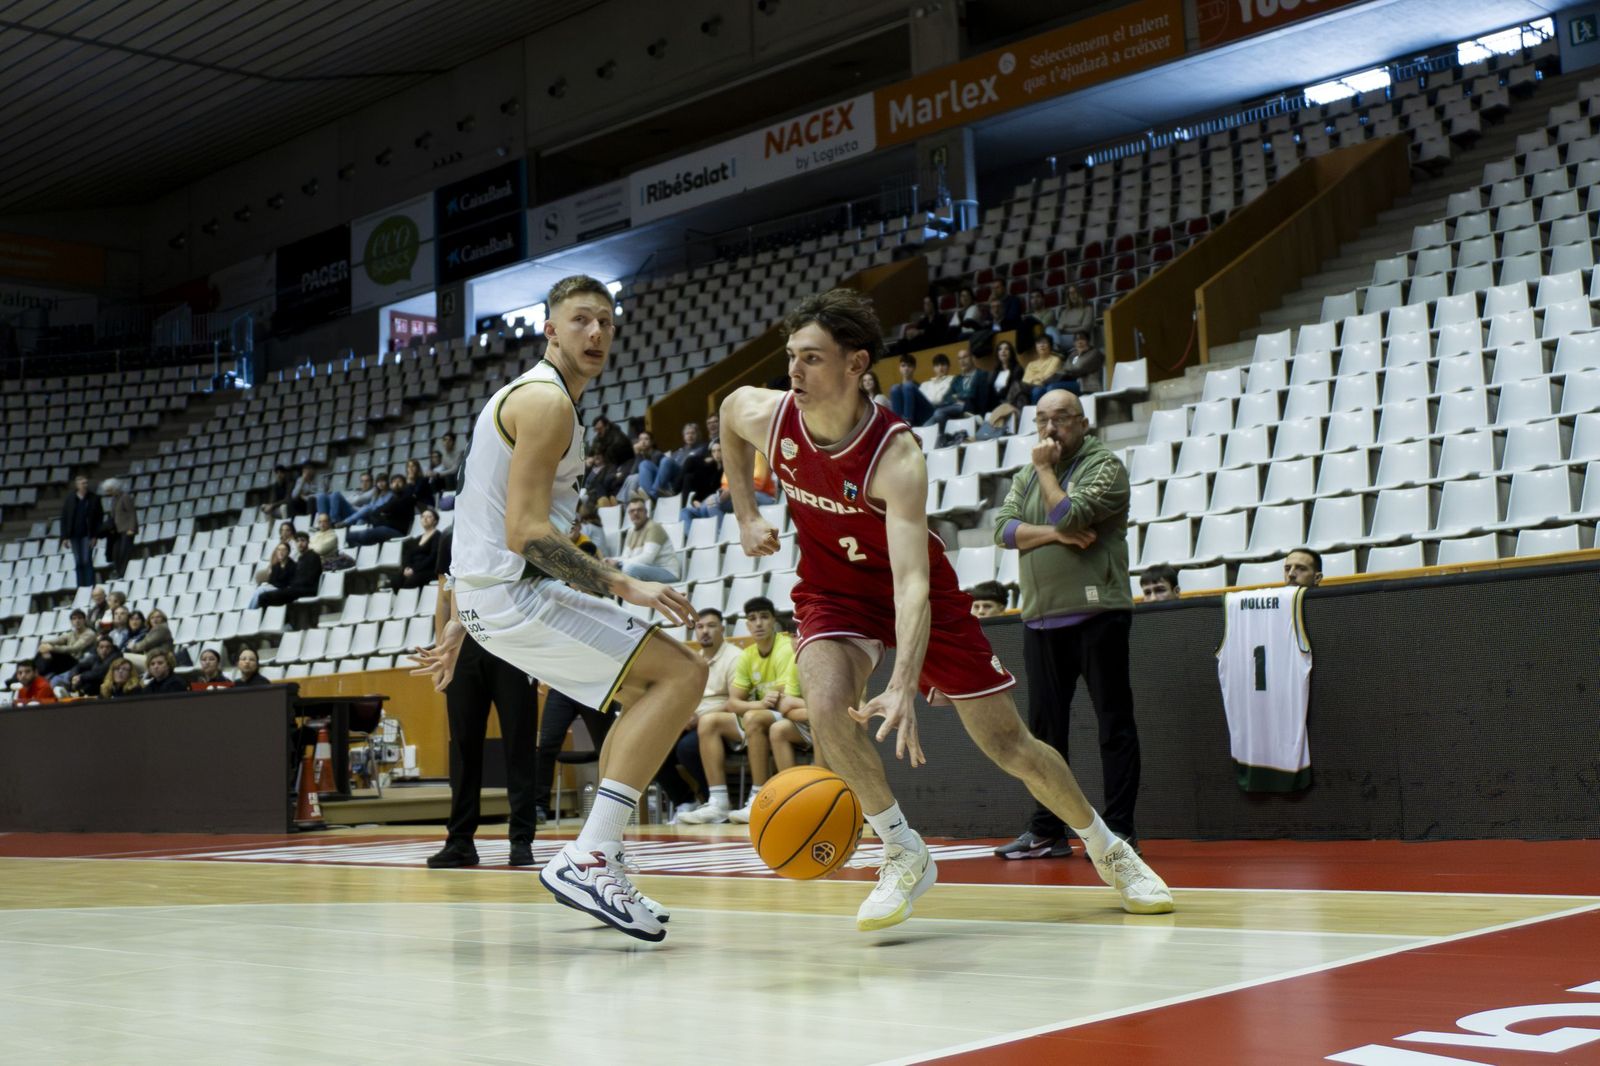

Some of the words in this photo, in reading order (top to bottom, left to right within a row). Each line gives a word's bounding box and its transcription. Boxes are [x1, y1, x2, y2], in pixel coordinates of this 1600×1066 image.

[1029, 34, 1110, 69] Seleccionem
[1113, 25, 1126, 42] el
[1129, 14, 1170, 36] talent
[1023, 74, 1047, 94] que
[1113, 51, 1120, 63] a
[888, 74, 1000, 134] Marlex
[764, 102, 855, 159] NACEX
[795, 155, 809, 170] by
[813, 140, 858, 165] Logista
[459, 179, 513, 211] CaixaBank
[646, 162, 729, 204] RibéSalat
[461, 231, 515, 263] CaixaBank
[838, 536, 867, 561] 2
[1253, 645, 1267, 691] 1
